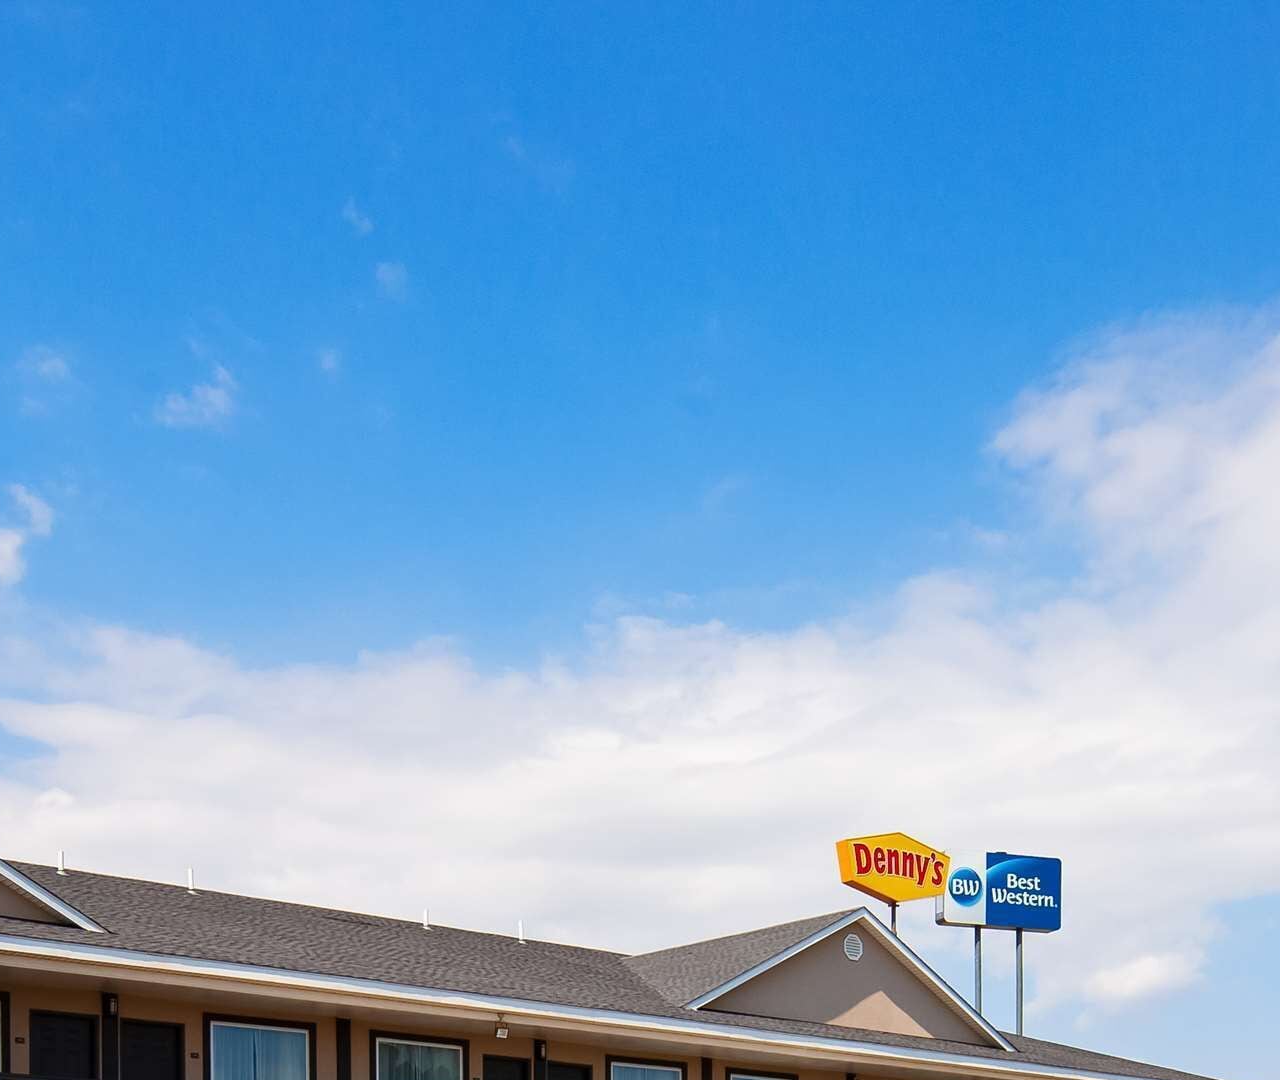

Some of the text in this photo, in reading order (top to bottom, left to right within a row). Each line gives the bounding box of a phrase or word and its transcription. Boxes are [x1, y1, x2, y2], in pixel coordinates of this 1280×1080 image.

[853, 843, 944, 886] Denny's
[952, 878, 979, 896] BW
[1006, 873, 1041, 891] Best
